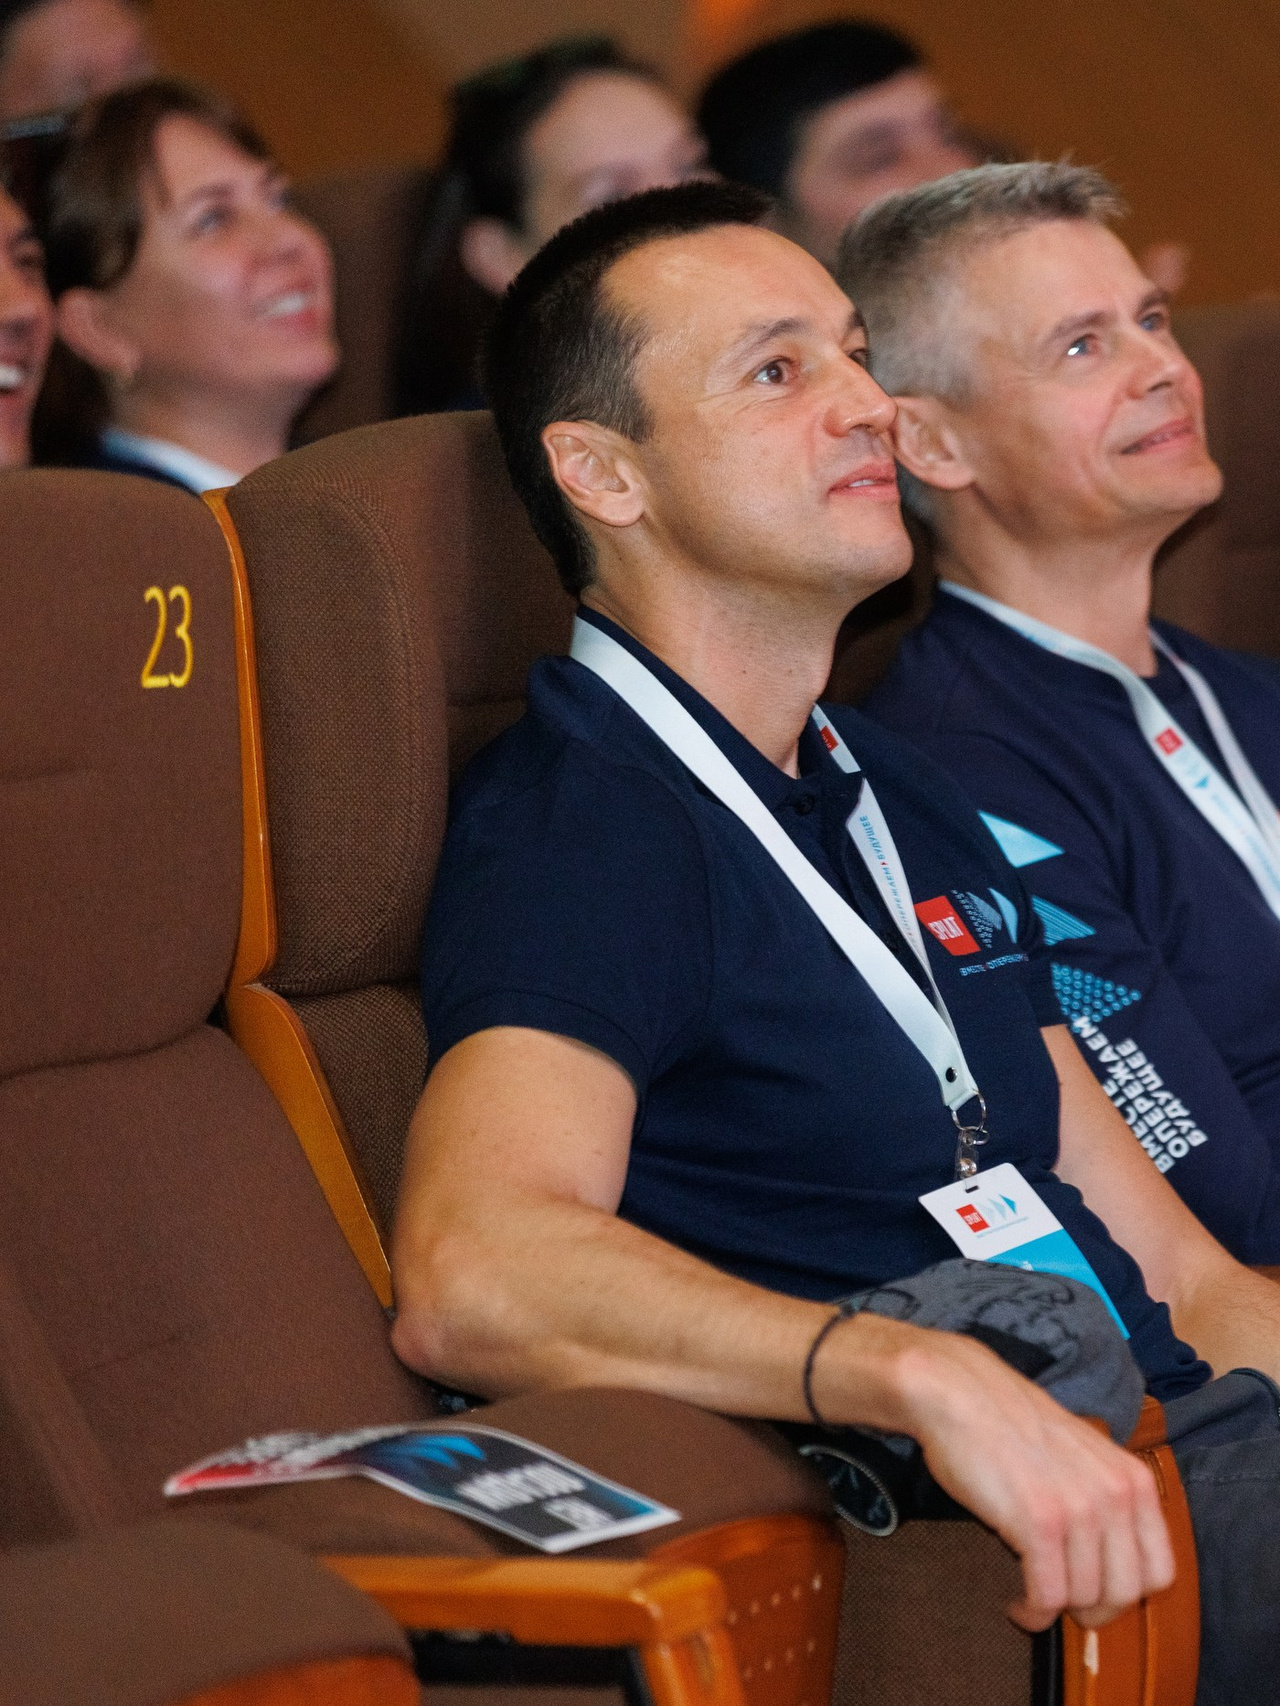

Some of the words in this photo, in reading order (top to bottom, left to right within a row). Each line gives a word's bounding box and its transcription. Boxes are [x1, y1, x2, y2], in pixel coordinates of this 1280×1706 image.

[141, 584, 194, 689] 23
[859, 814, 886, 860] БУДУЩЕЕ
[1073, 1015, 1190, 1159] ОПЕРЕЖАЕМ
[1115, 1037, 1209, 1147] БУДУЩЕЕ
